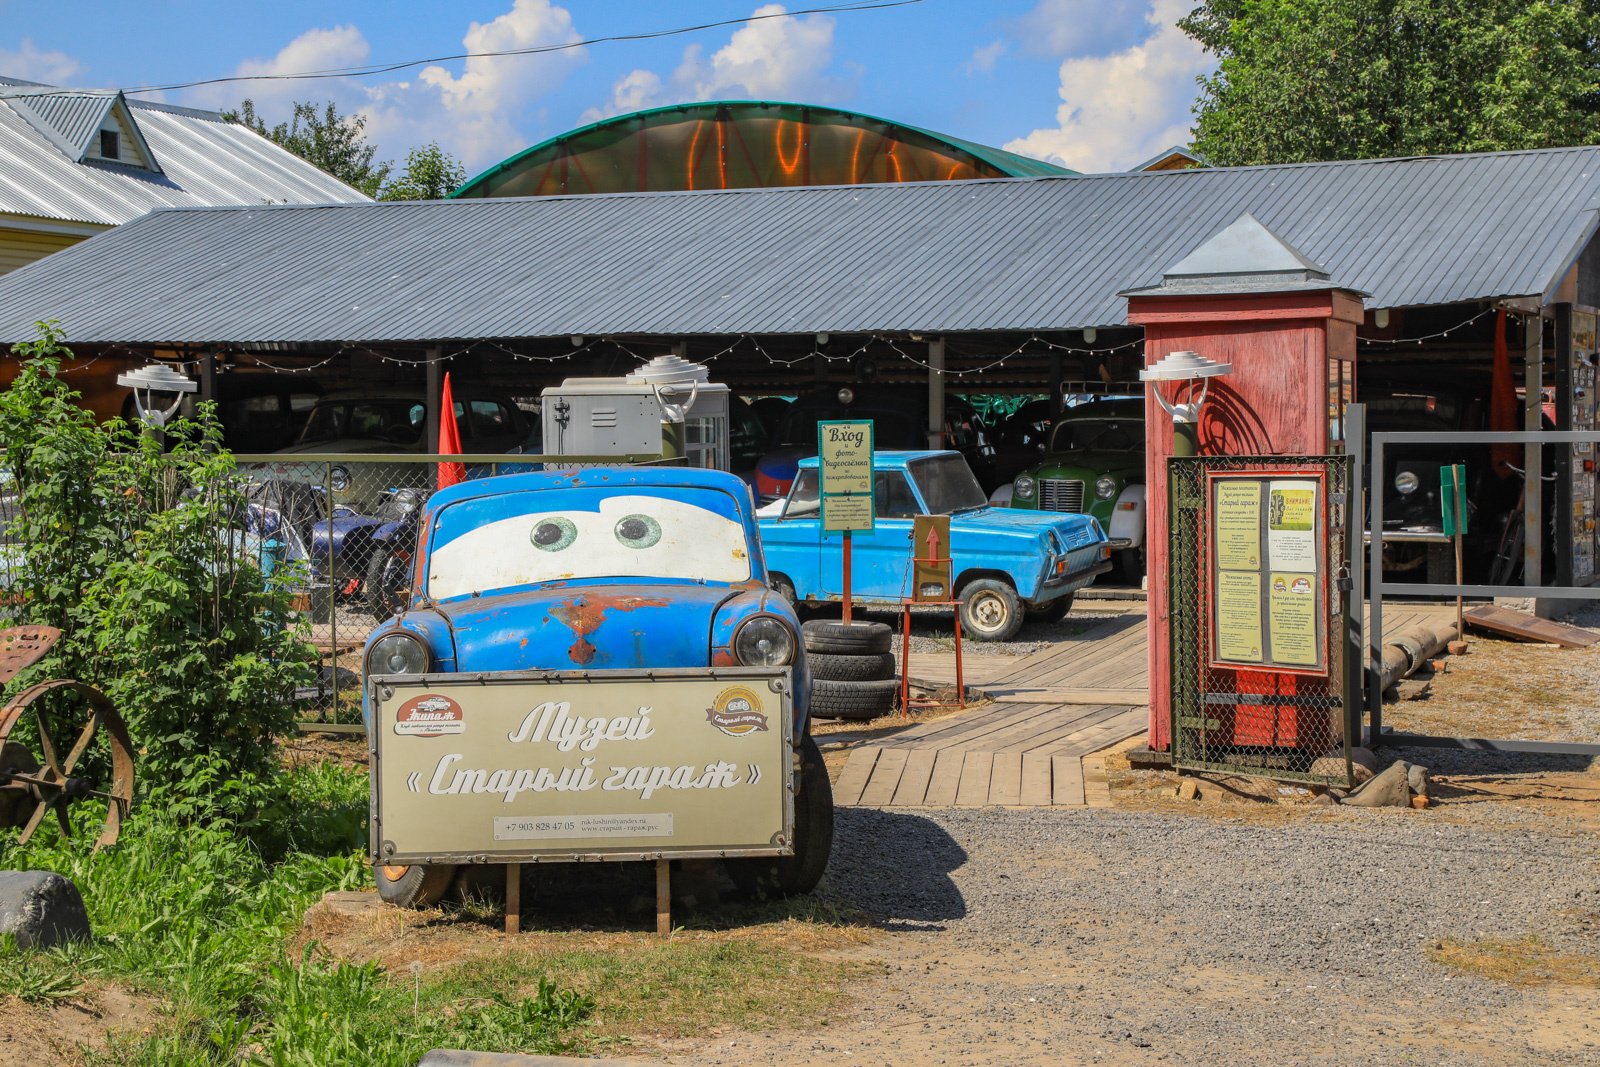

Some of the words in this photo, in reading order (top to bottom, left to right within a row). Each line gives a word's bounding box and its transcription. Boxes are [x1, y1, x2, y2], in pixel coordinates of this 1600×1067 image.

[829, 427, 864, 448] Вход
[406, 708, 456, 721] Экипаж
[508, 701, 656, 752] Музей
[505, 823, 517, 832] +7
[518, 822, 534, 832] 903
[535, 822, 550, 831] 828
[551, 822, 563, 831] 47
[564, 821, 576, 830] 05
